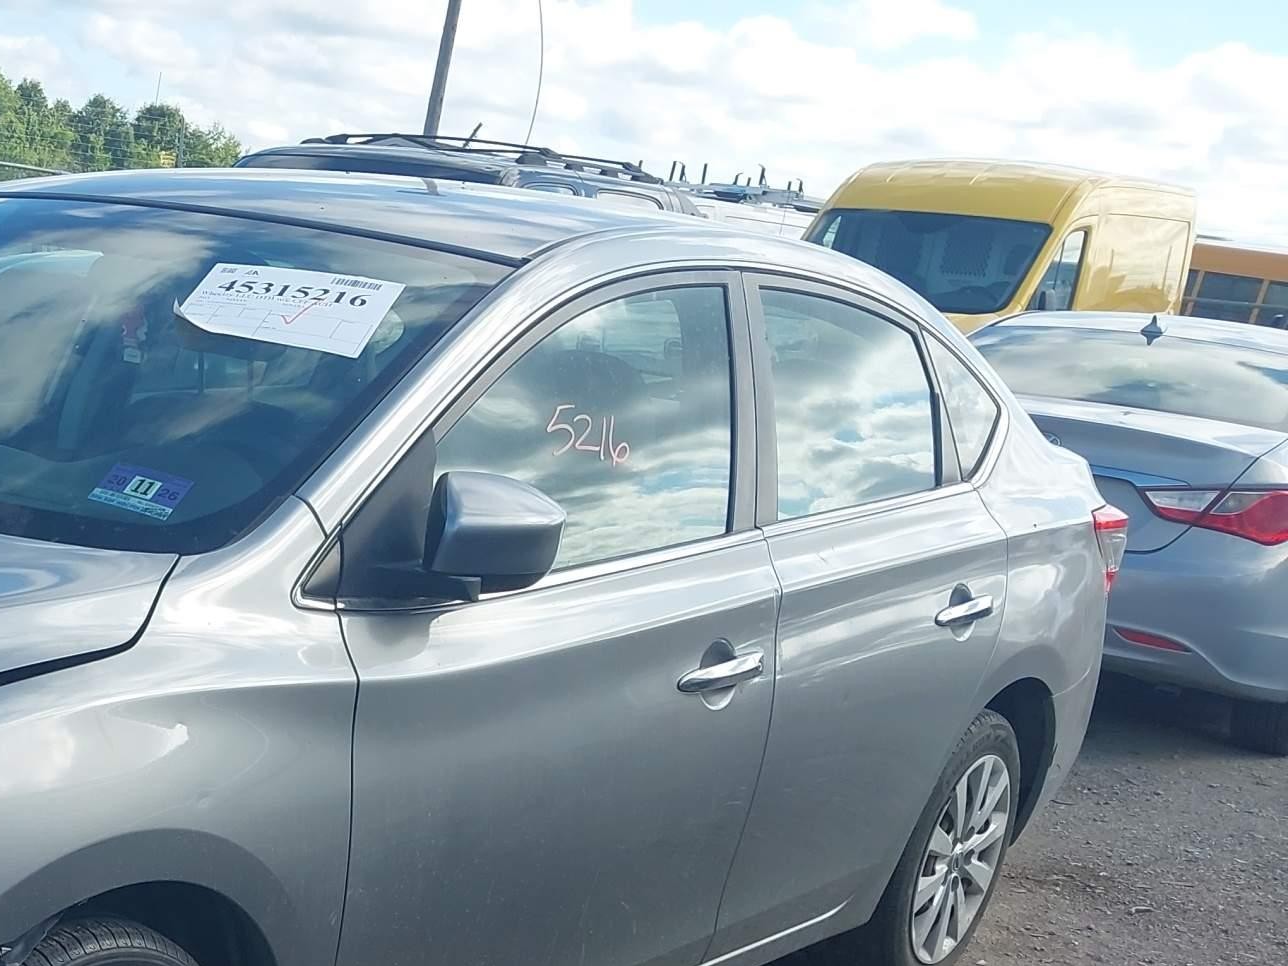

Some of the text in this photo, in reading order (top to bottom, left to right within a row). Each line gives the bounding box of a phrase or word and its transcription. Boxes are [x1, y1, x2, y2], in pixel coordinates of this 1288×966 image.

[218, 279, 372, 308] 45315216
[547, 405, 630, 466] 5216
[131, 479, 155, 497] 11
[158, 488, 180, 501] 26
